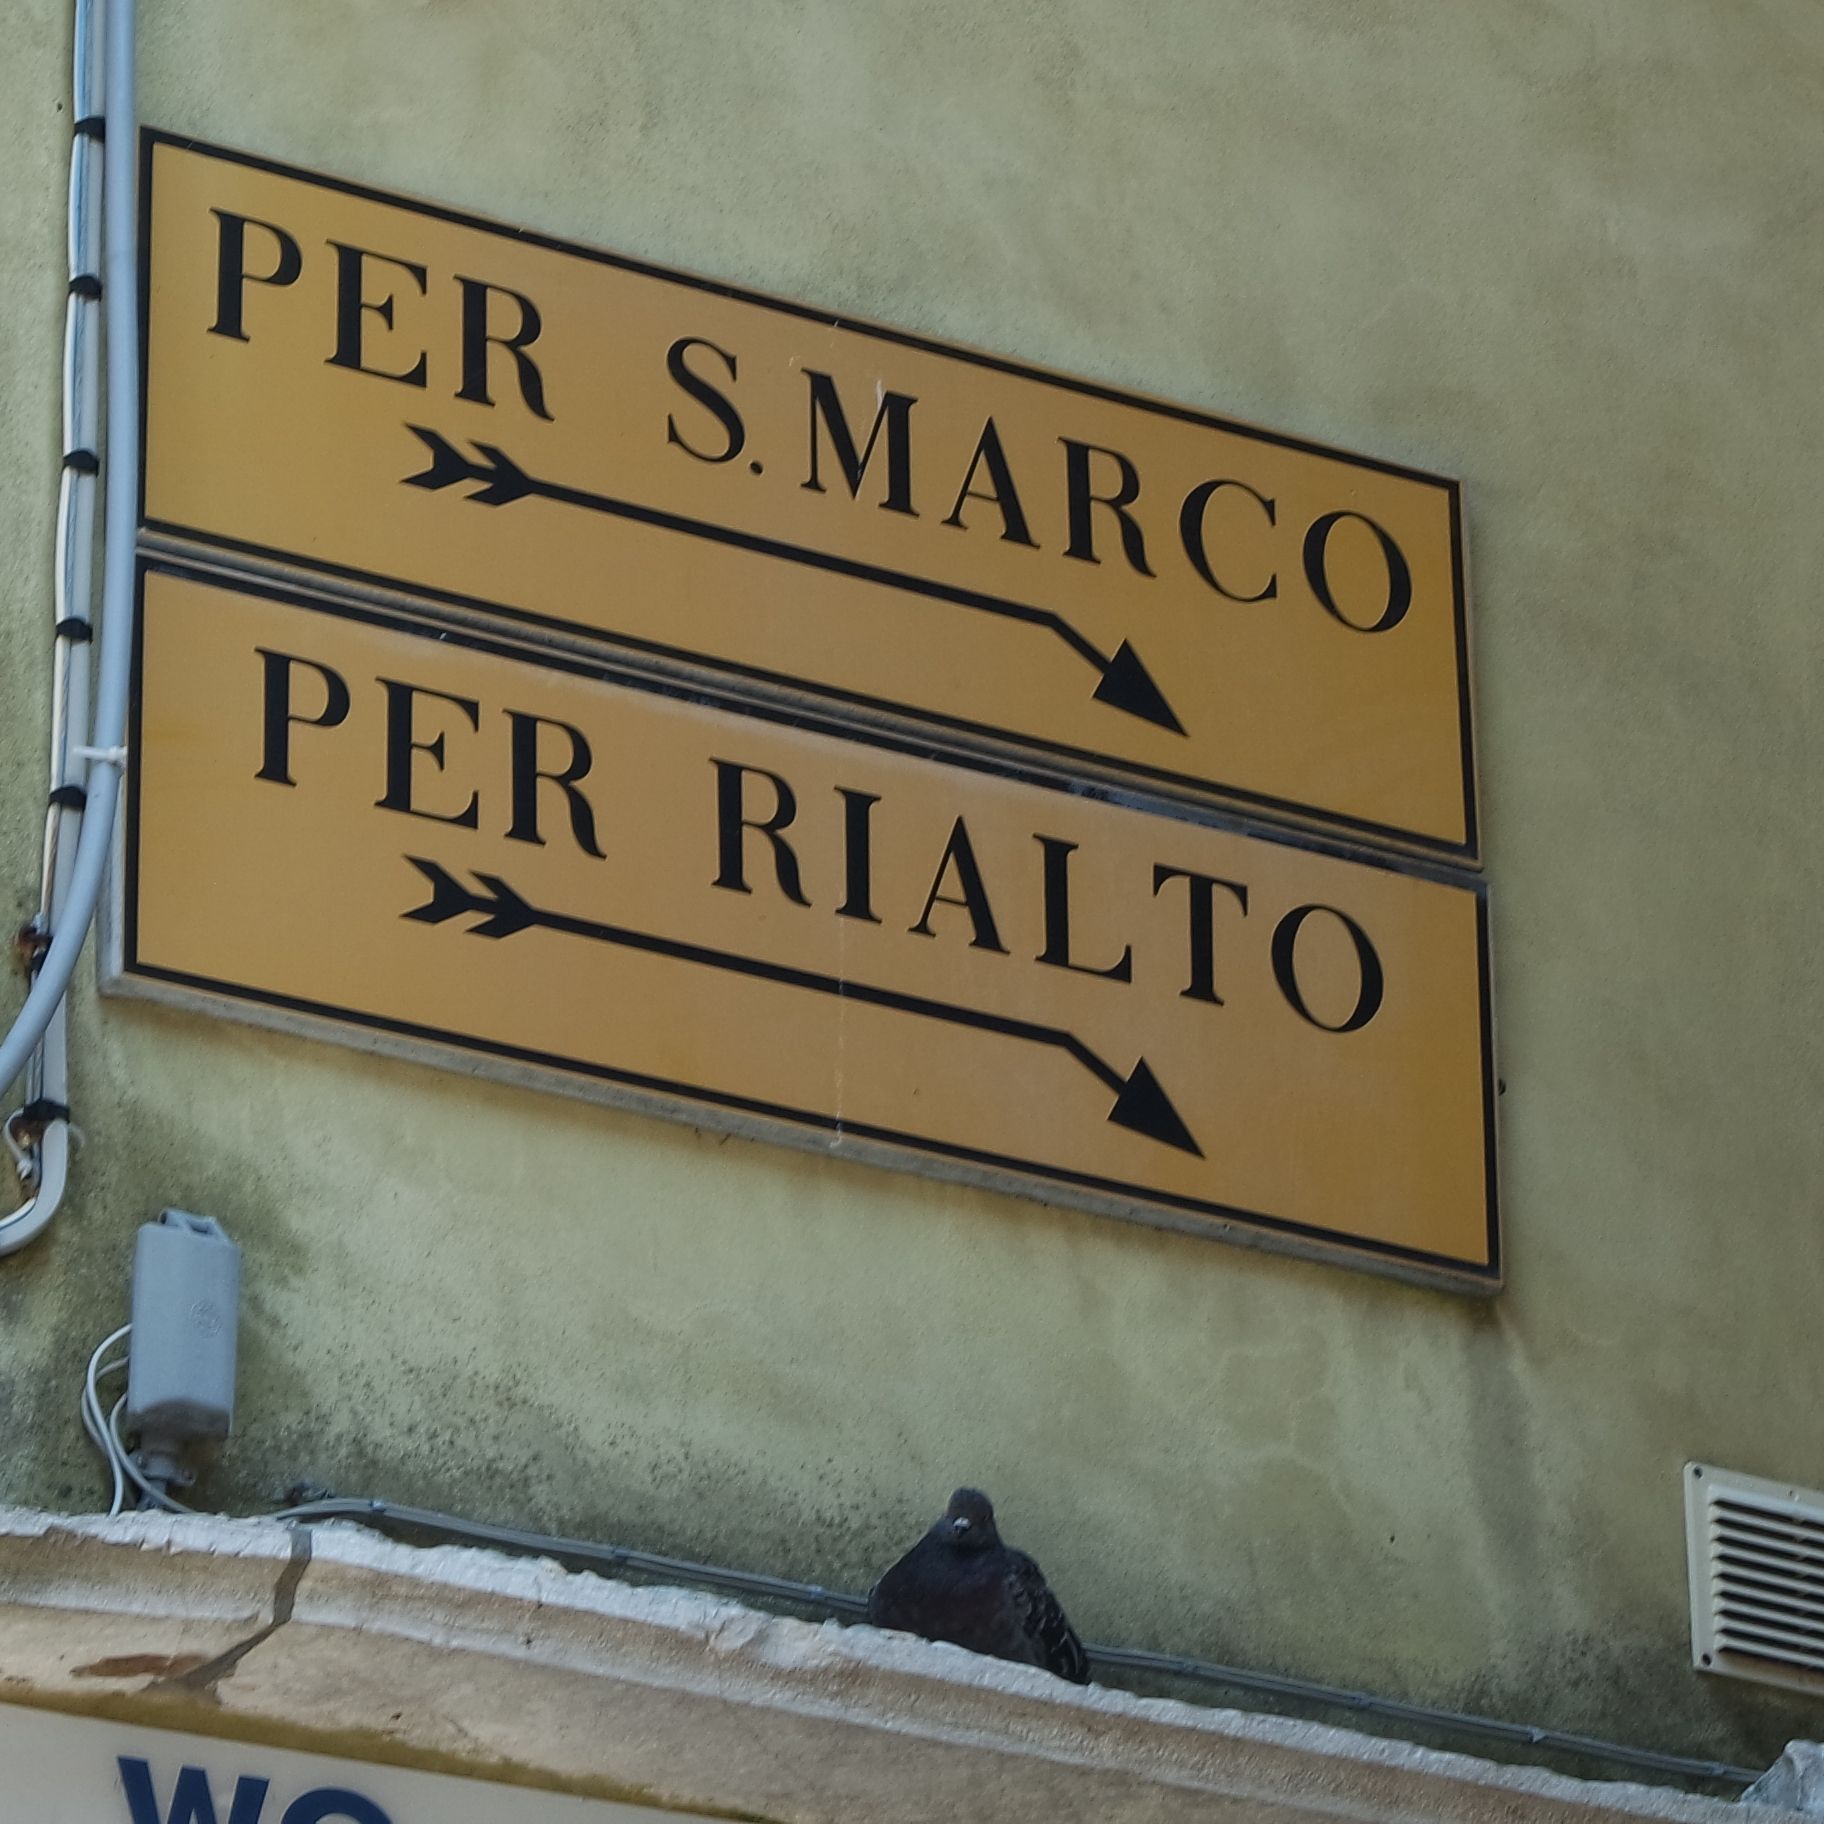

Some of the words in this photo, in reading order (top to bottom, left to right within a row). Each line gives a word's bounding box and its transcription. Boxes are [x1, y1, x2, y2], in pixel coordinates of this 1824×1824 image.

[206, 207, 555, 423] PER
[665, 337, 1414, 635] S.MARCO
[253, 647, 607, 861] PER
[709, 757, 1385, 1035] RIALTO
